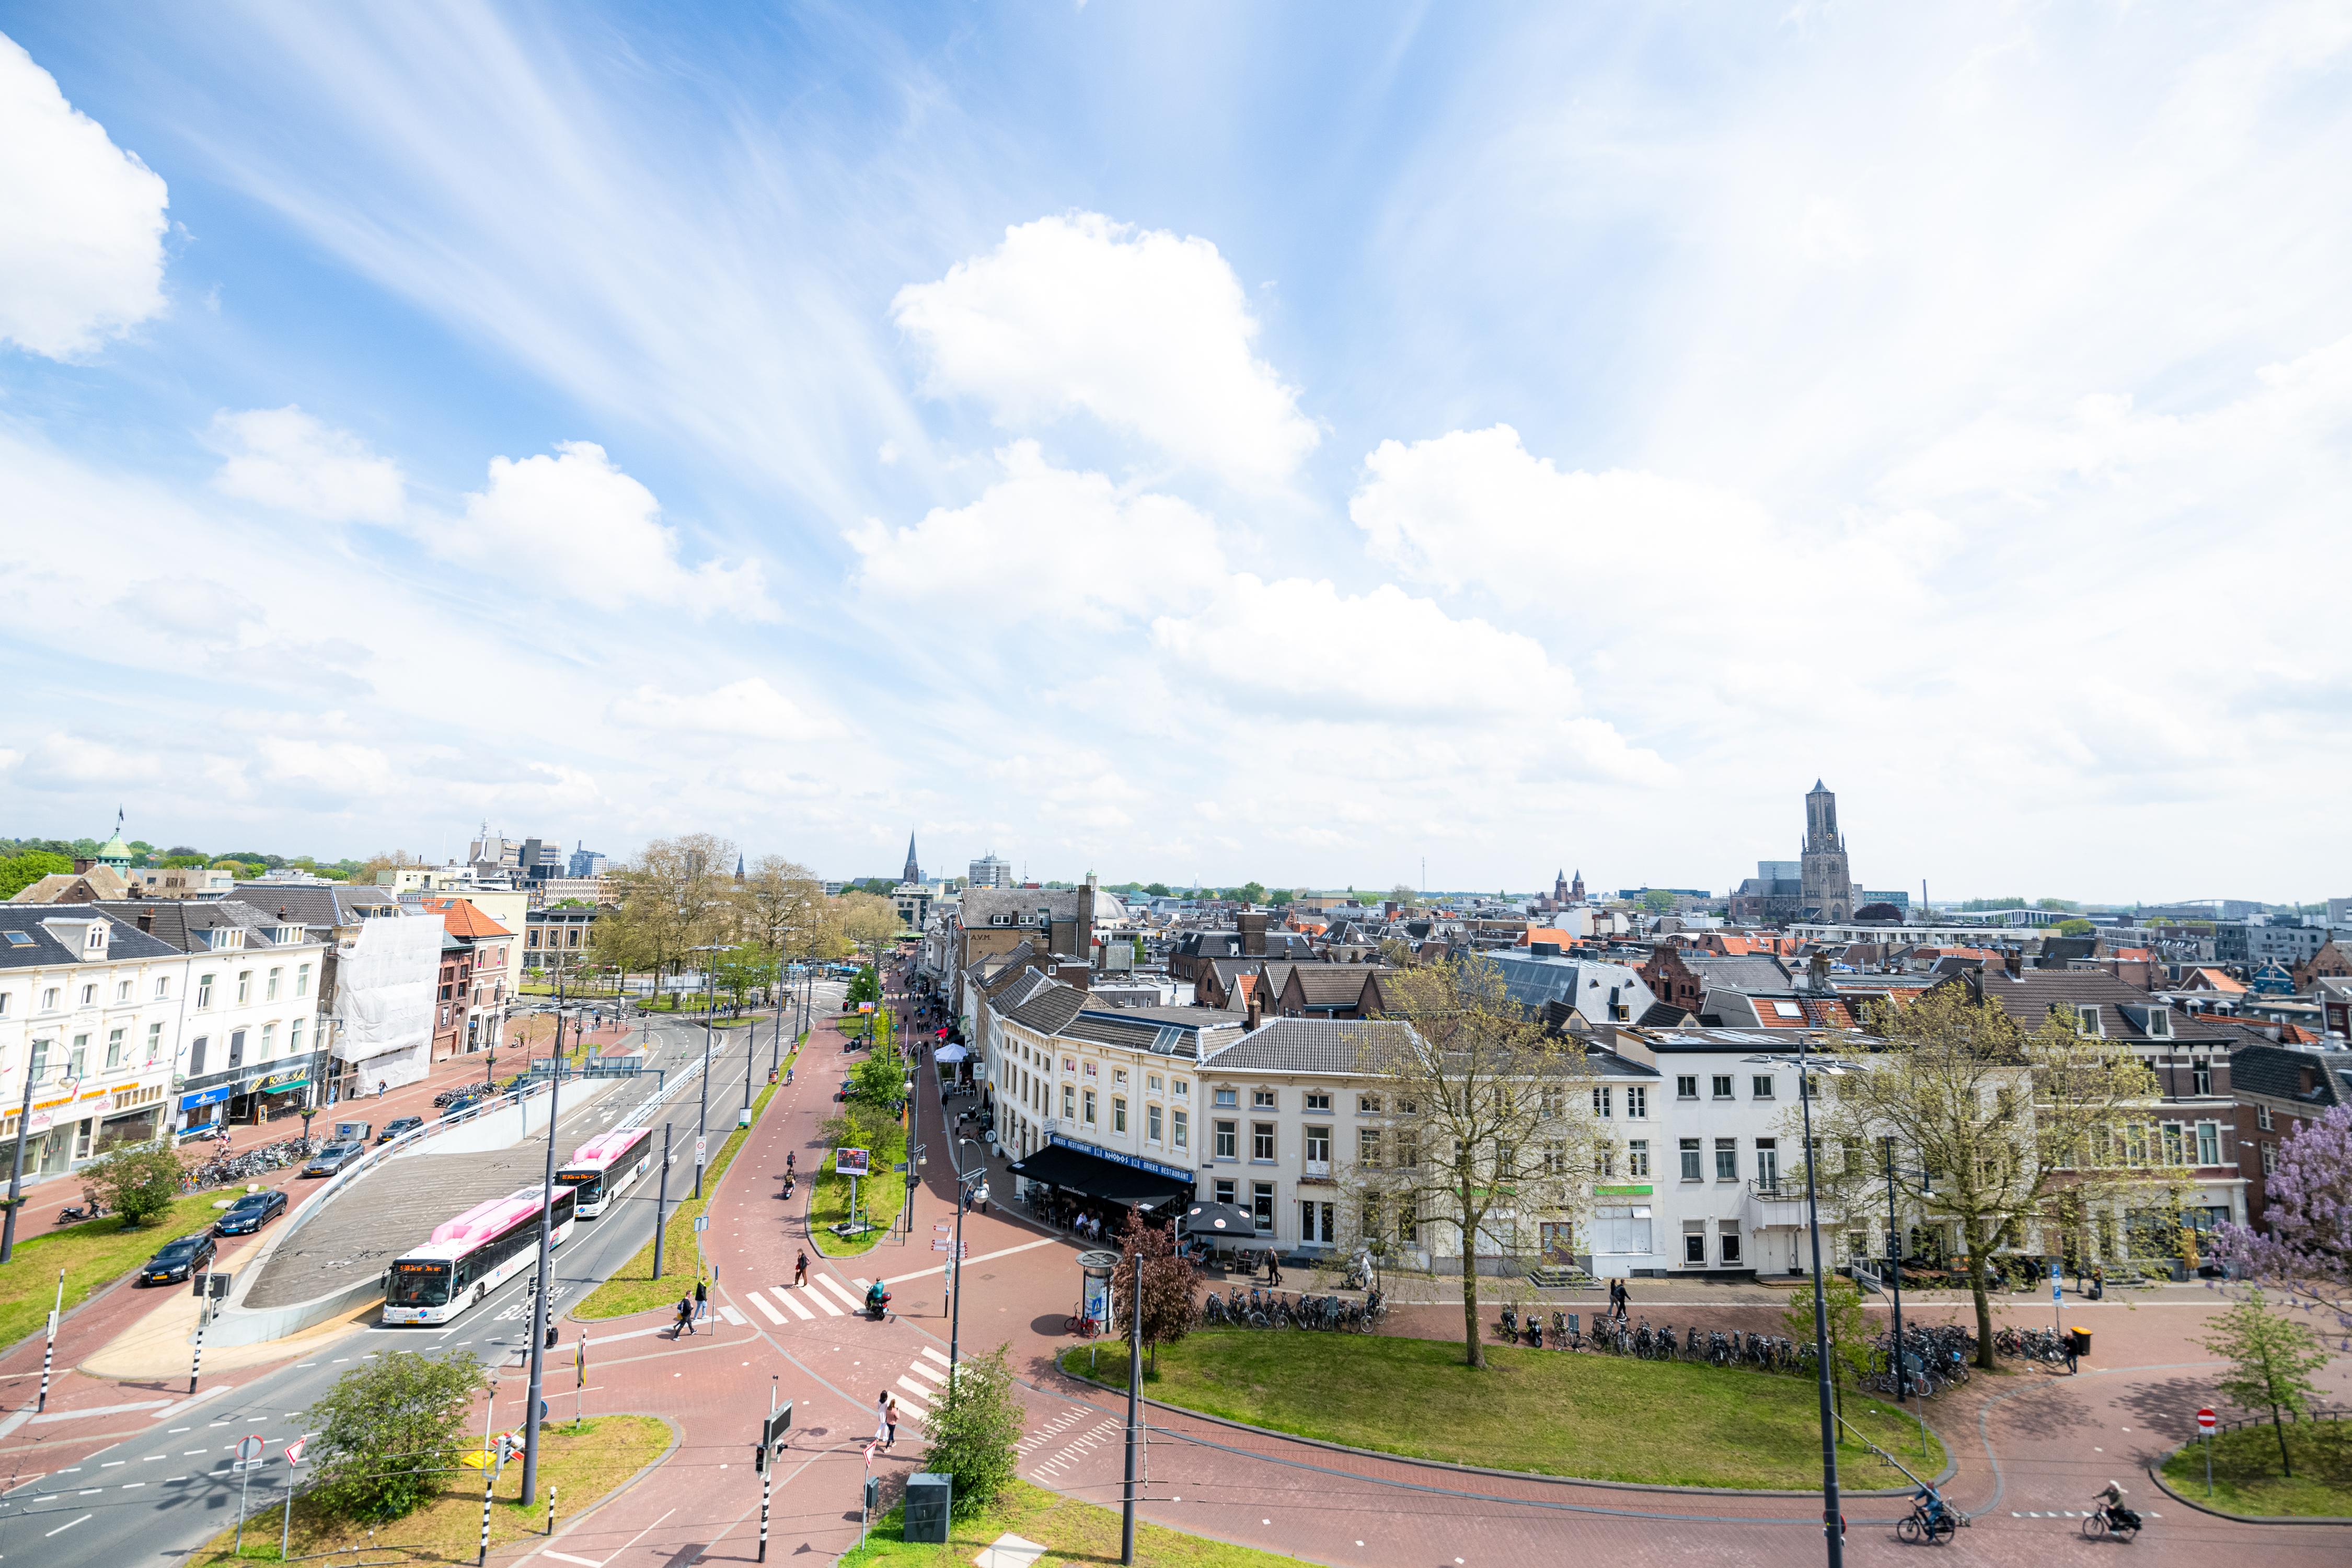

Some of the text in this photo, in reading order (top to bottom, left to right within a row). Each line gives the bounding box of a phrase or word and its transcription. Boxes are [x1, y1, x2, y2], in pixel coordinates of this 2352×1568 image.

[1053, 1136, 1189, 1181] GRIEKS RESTAURANT RHODOS GRIEKS RESTAURANT
